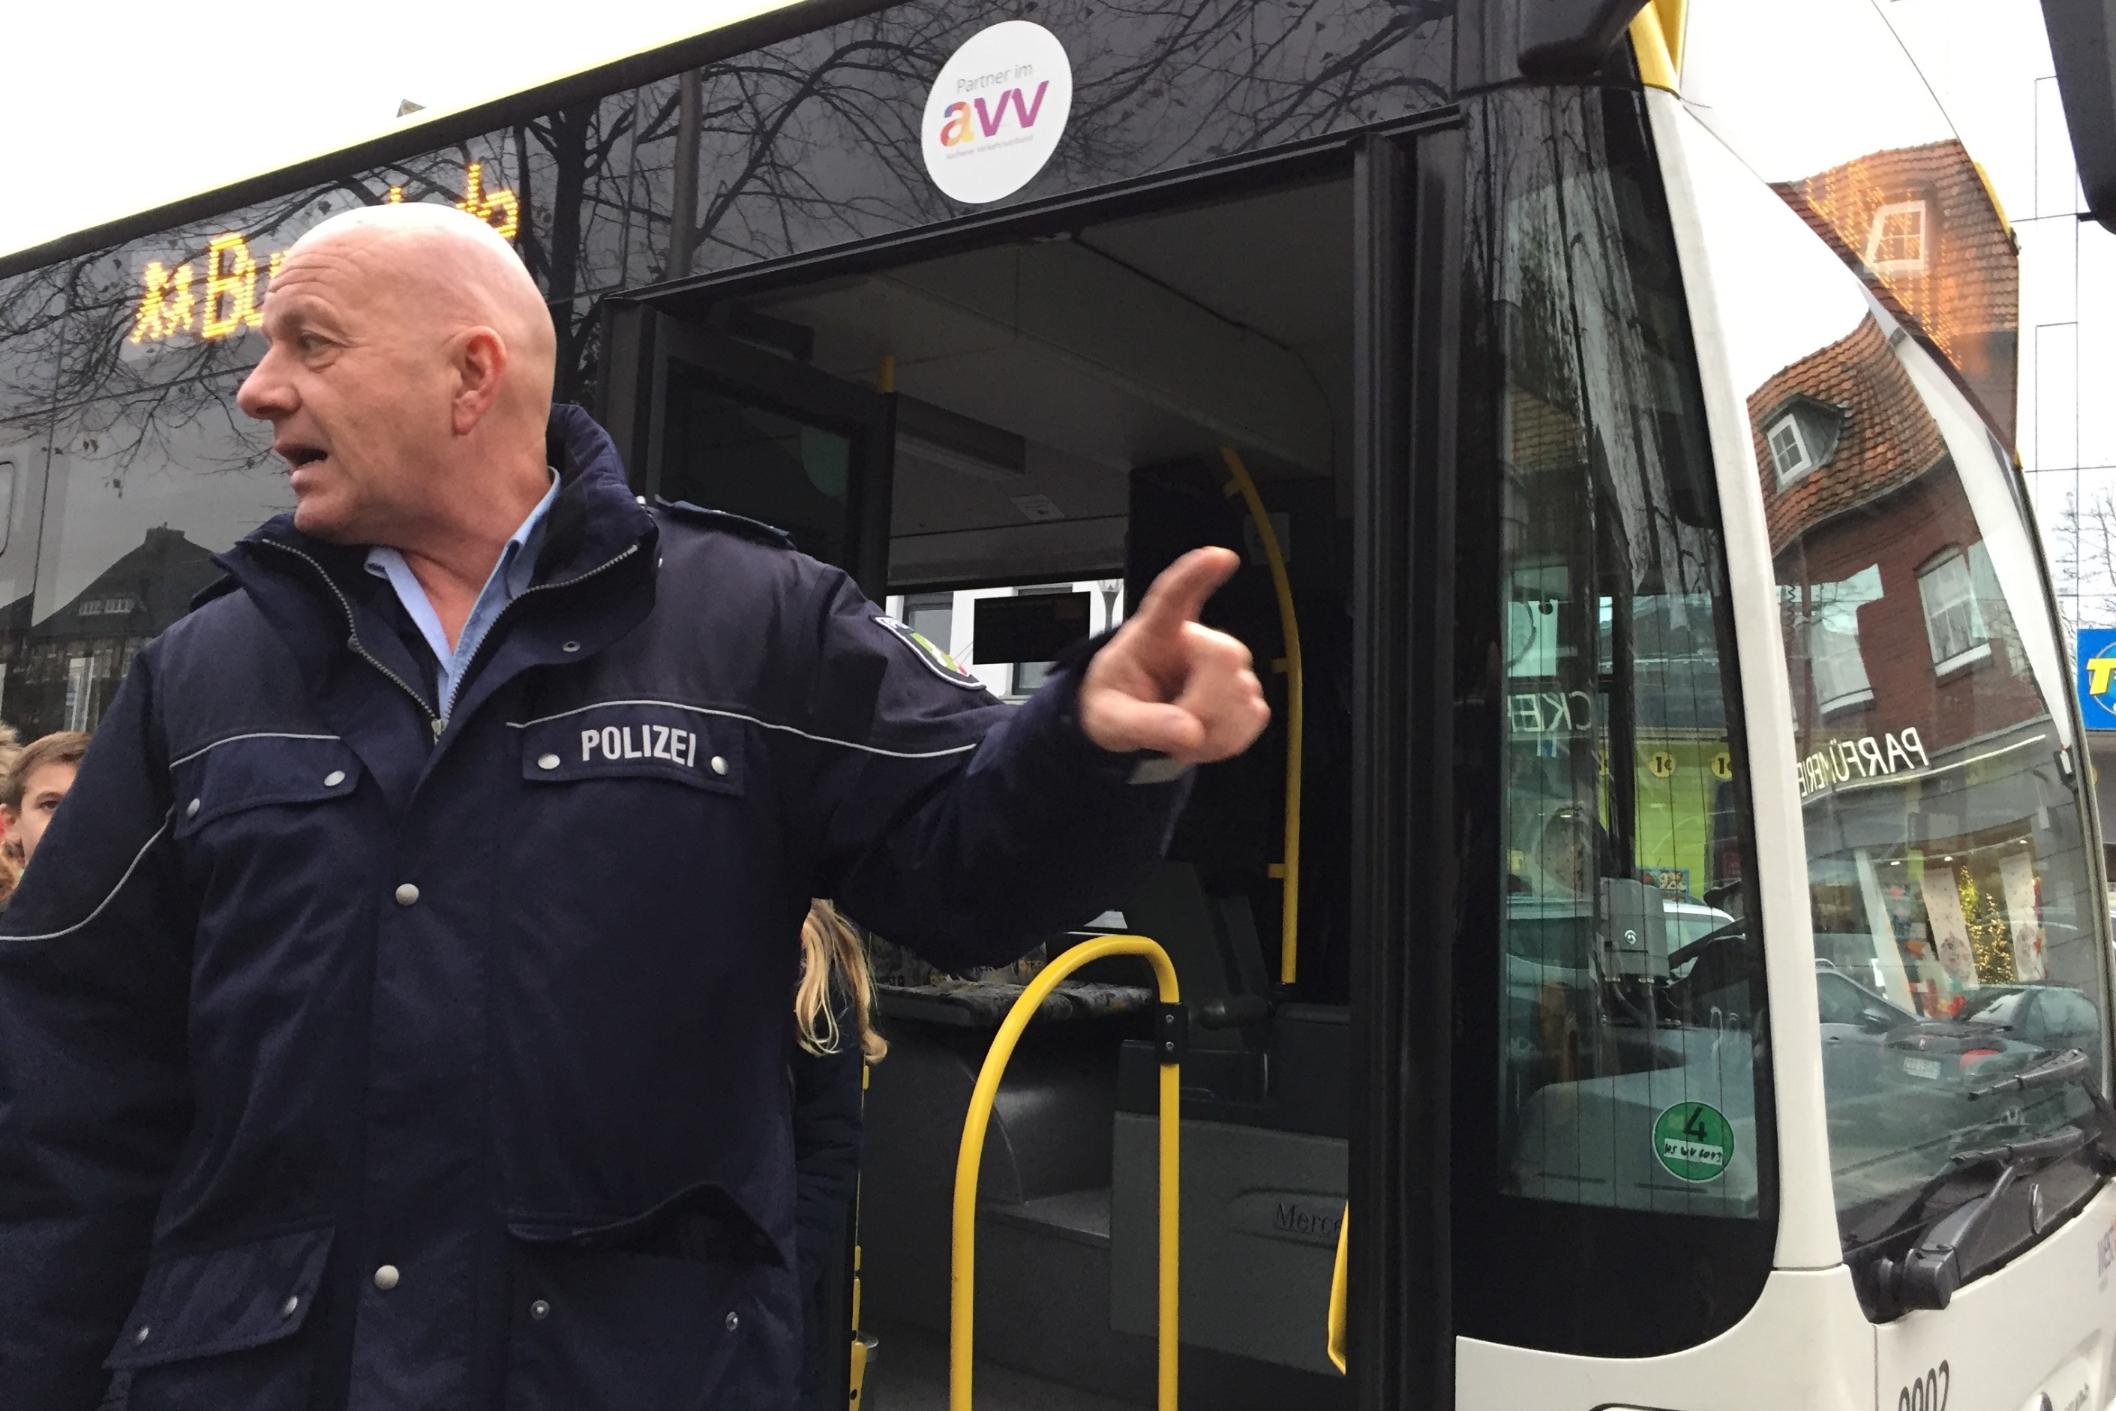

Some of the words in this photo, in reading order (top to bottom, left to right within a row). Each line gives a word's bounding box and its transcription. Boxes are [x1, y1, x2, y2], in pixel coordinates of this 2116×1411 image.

[956, 69, 1011, 94] Partner
[1014, 63, 1034, 79] im
[939, 79, 1050, 148] avv
[581, 724, 696, 768] POLIZEI
[1682, 1106, 1708, 1142] 4
